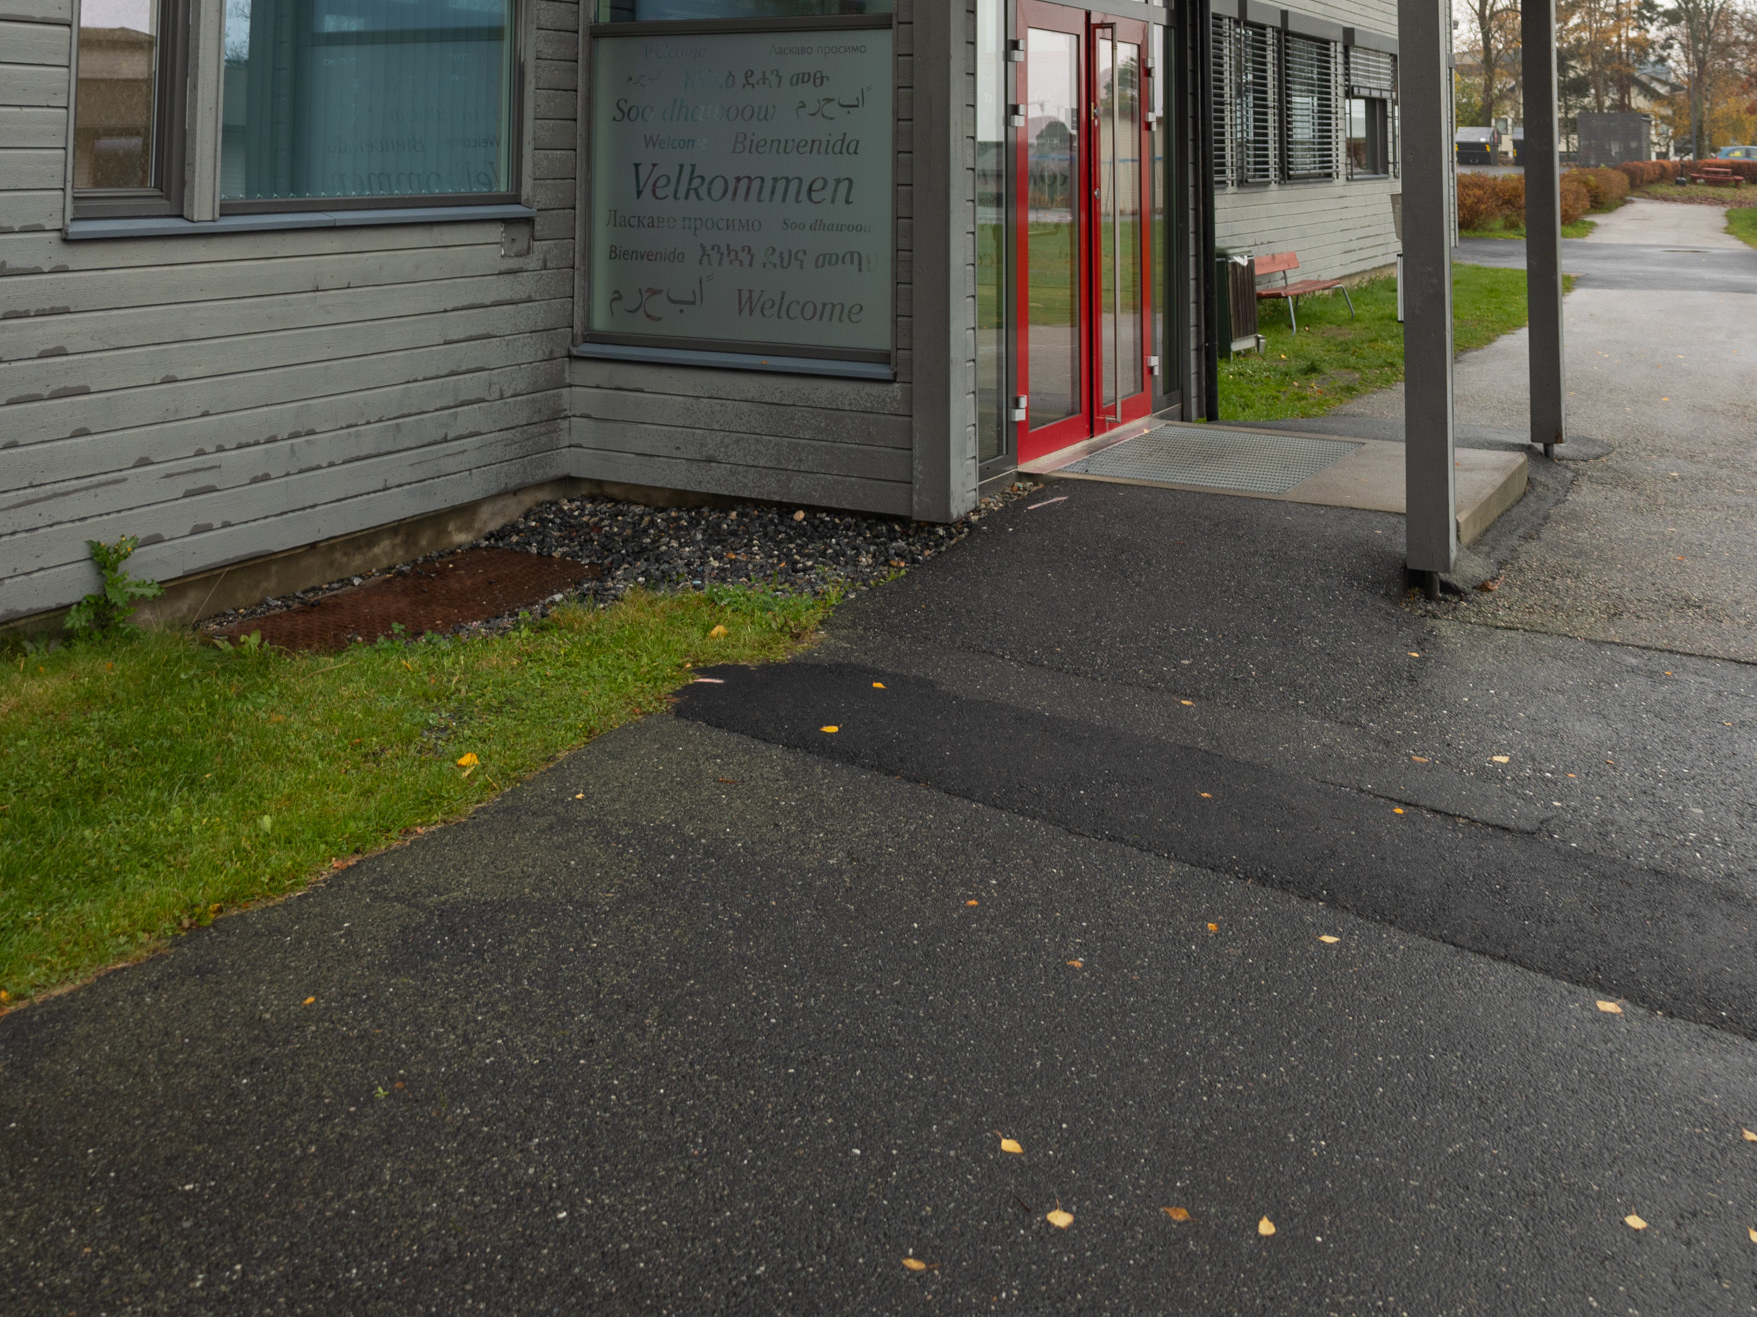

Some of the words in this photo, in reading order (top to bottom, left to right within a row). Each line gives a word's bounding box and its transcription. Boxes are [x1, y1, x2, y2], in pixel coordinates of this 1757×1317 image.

[816, 43, 867, 58] просимо
[731, 132, 860, 155] Bienvenida
[633, 162, 854, 205] Velkommen
[606, 209, 677, 230] Ласкаво
[682, 215, 762, 236] просимо
[781, 217, 805, 231] Soo
[608, 244, 685, 263] Bienvenida
[736, 288, 864, 324] Welcome
